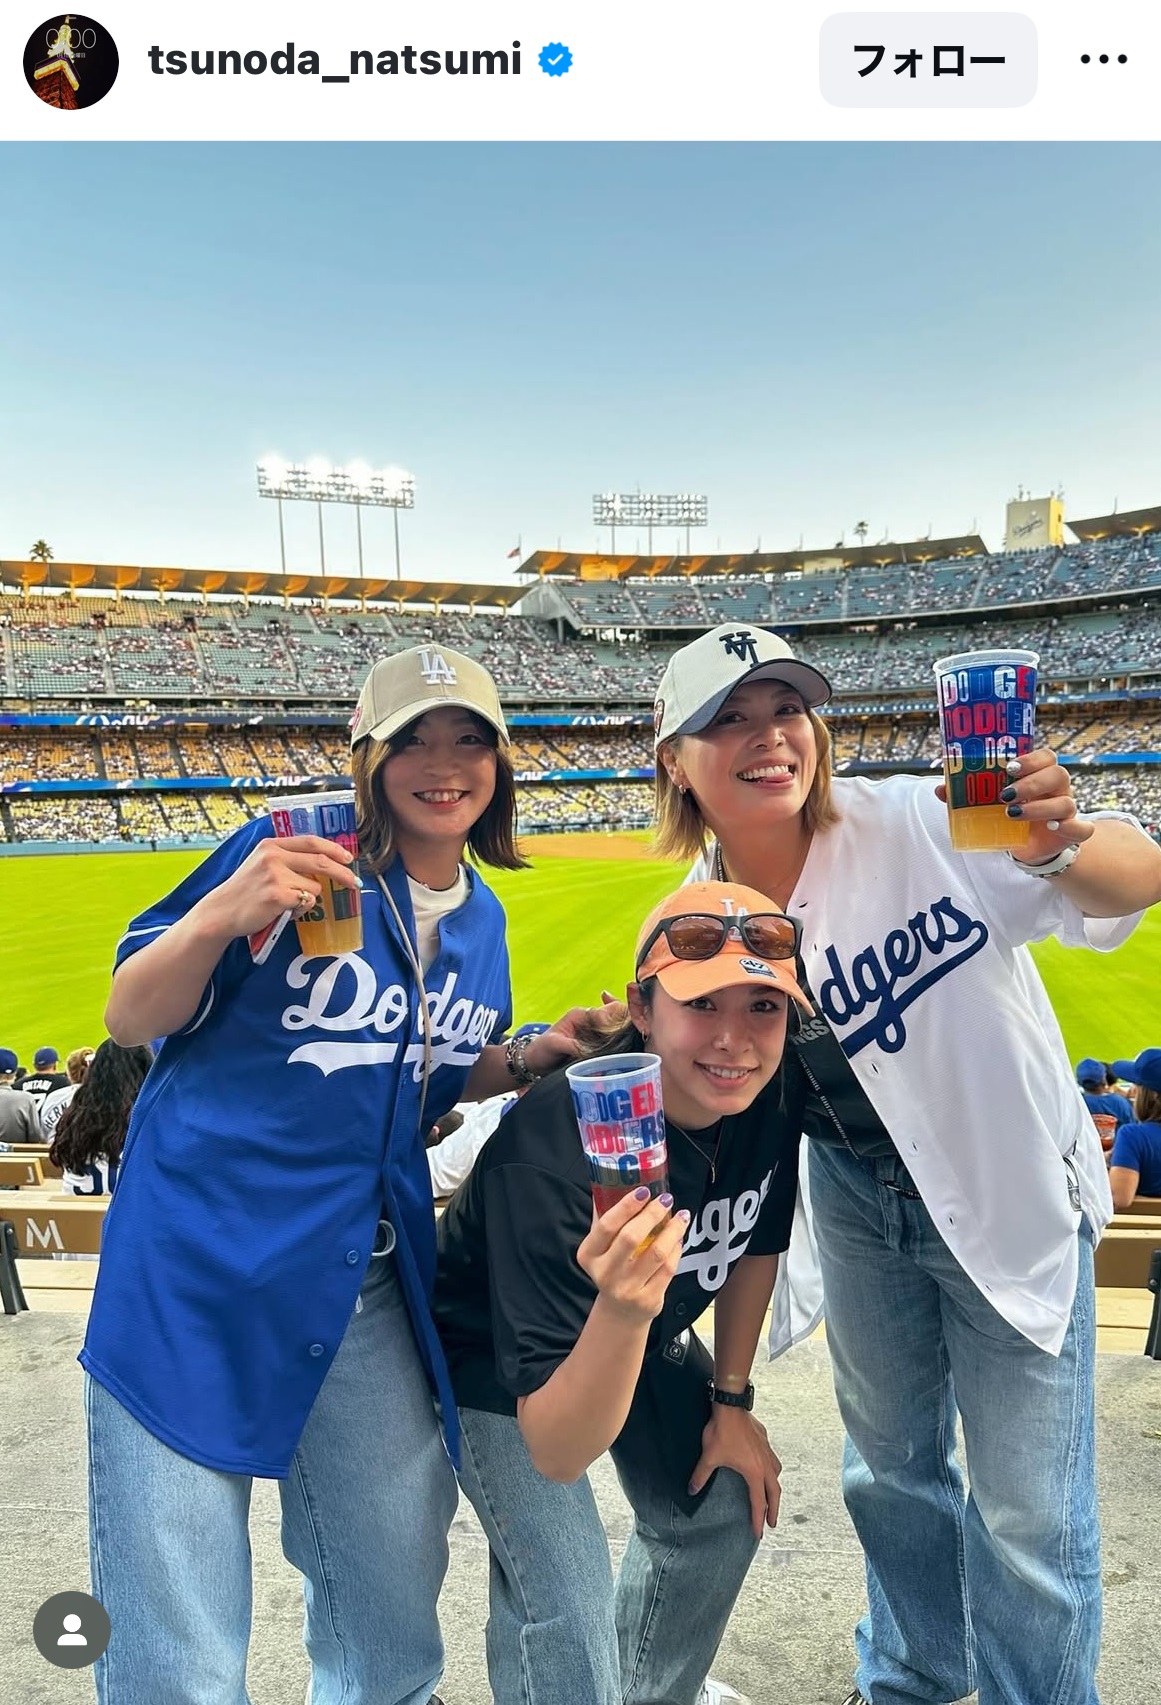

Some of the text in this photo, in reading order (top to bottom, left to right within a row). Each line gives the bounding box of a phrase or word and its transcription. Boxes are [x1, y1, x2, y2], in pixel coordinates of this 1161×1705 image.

[417, 648, 458, 685] LA
[27, 1166, 36, 1183] J
[26, 1218, 65, 1250] M
